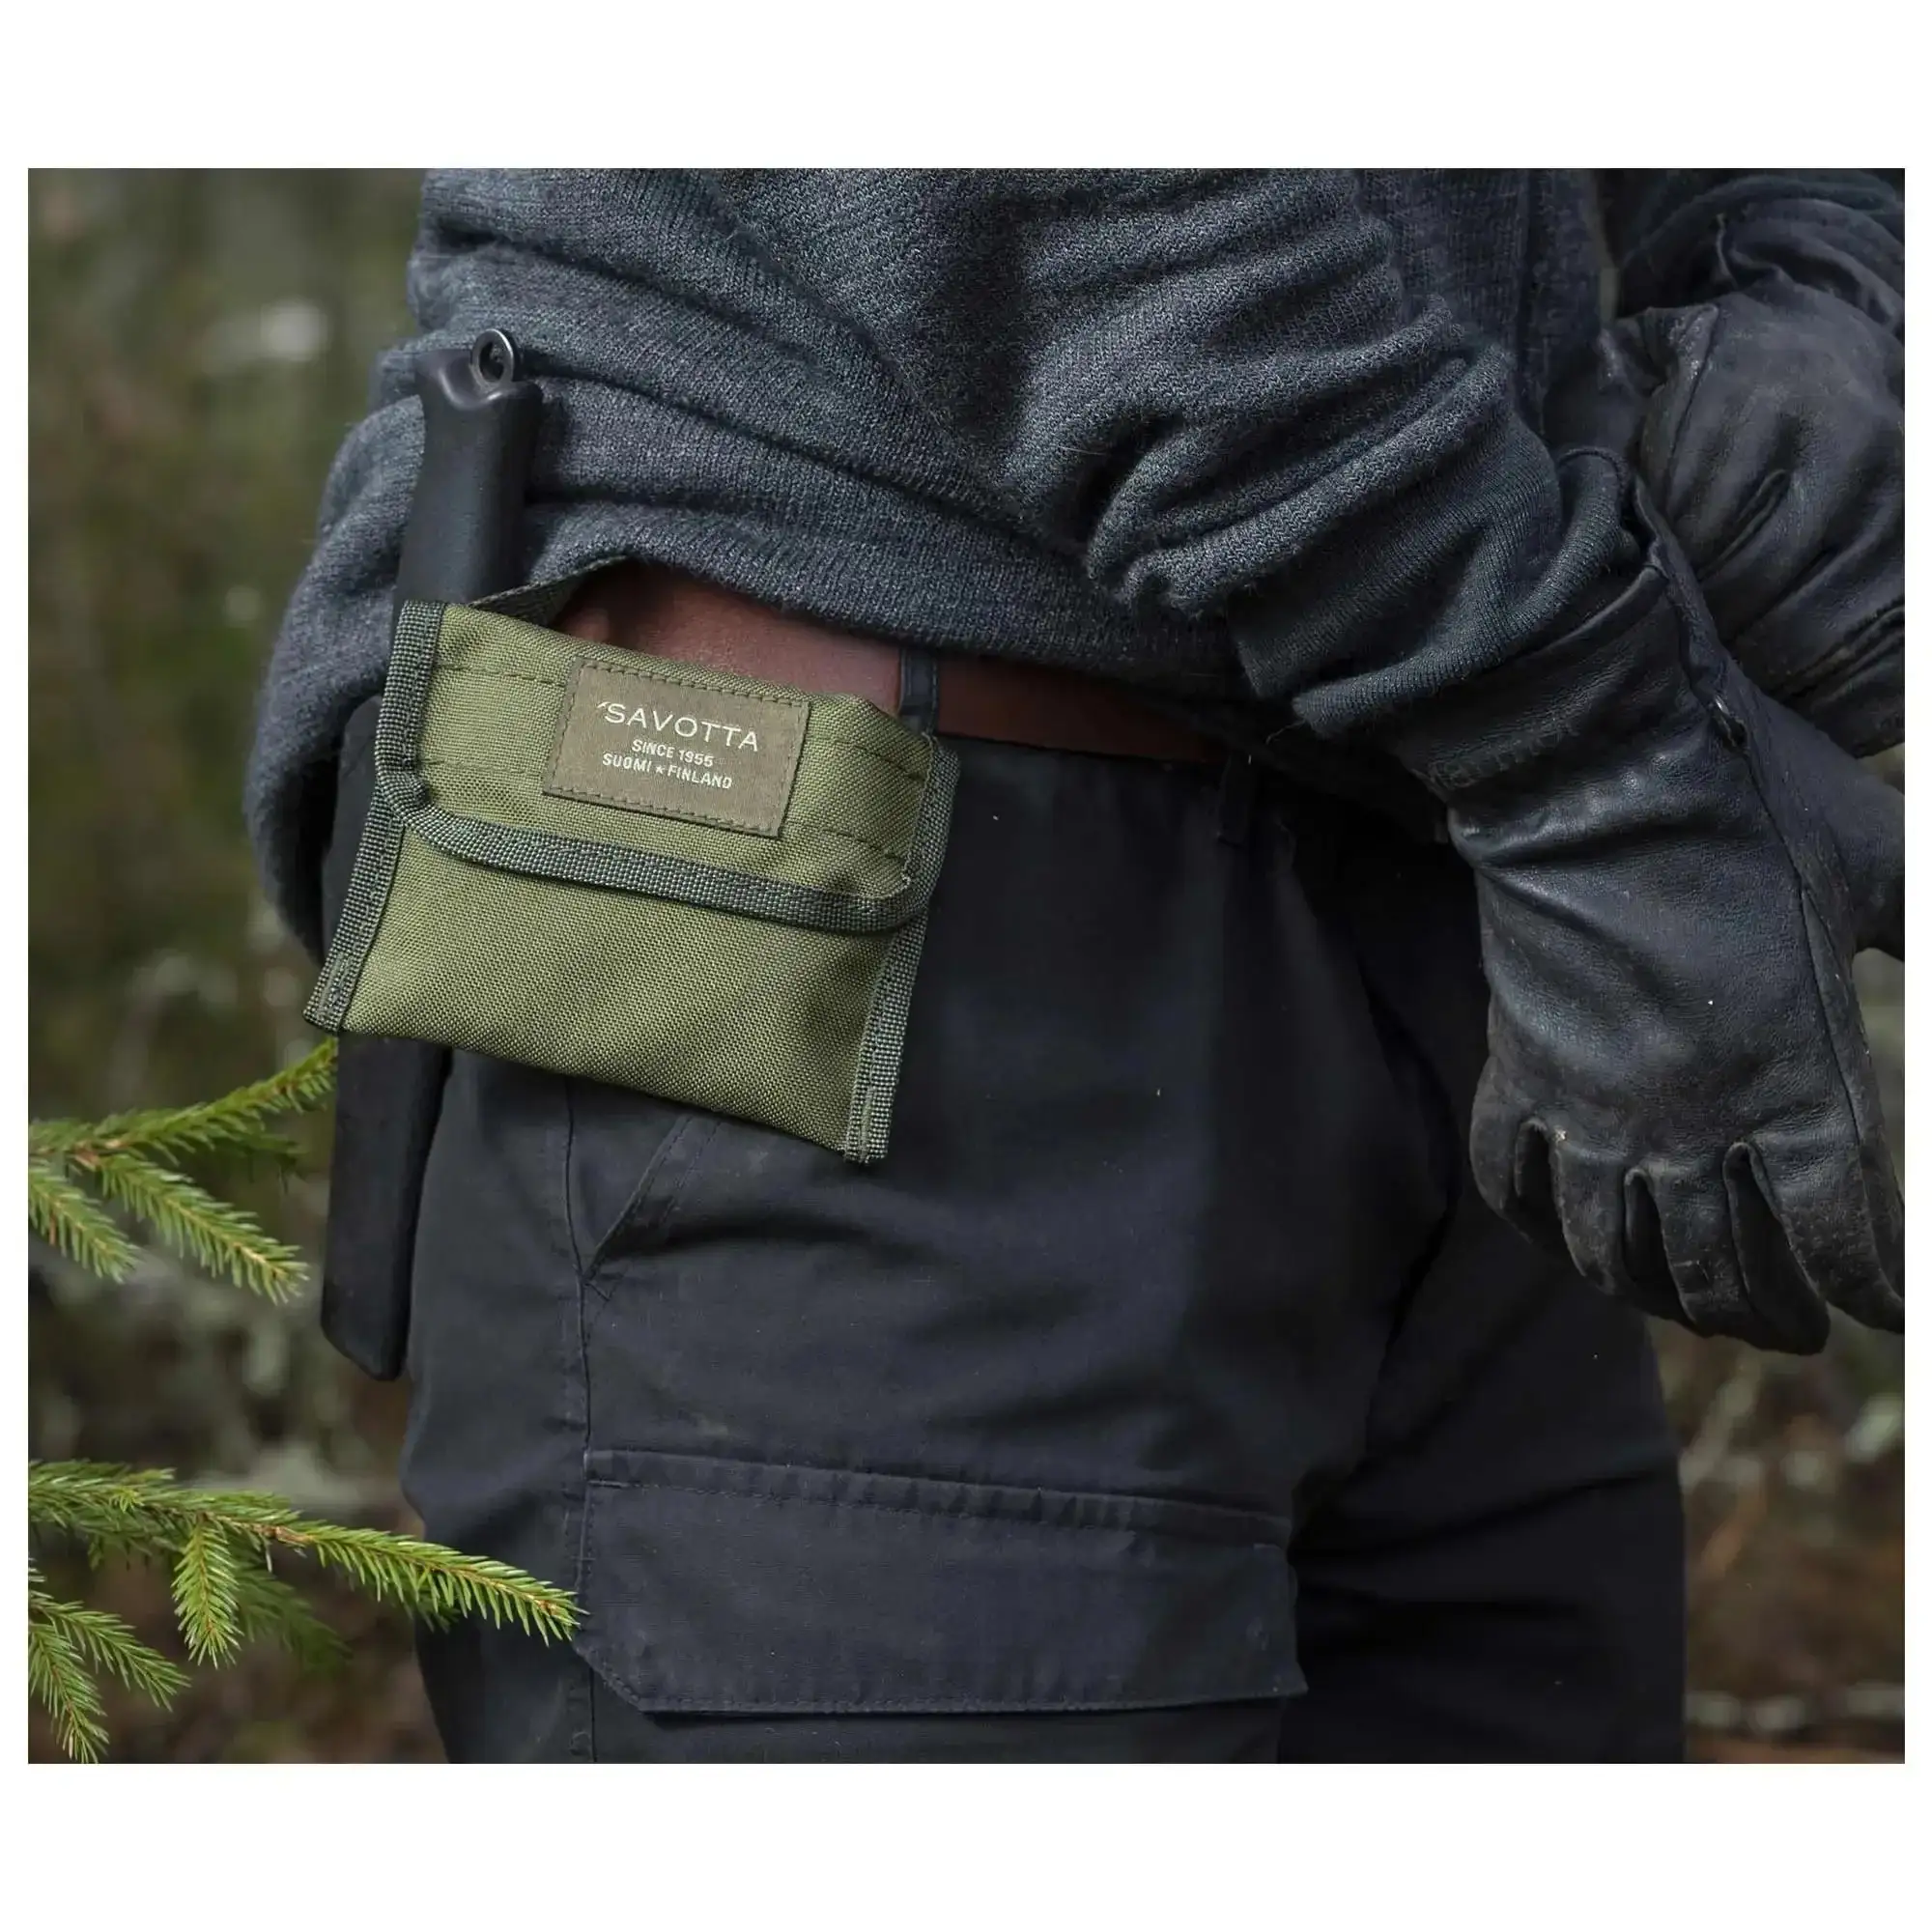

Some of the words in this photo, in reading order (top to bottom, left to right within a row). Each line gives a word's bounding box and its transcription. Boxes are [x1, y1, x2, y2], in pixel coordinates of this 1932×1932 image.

[598, 702, 758, 752] SAVOTTA
[602, 753, 651, 773] SUOMI
[668, 766, 732, 789] FINLAND
[631, 739, 674, 758] SINCE
[679, 750, 714, 767] 1955
